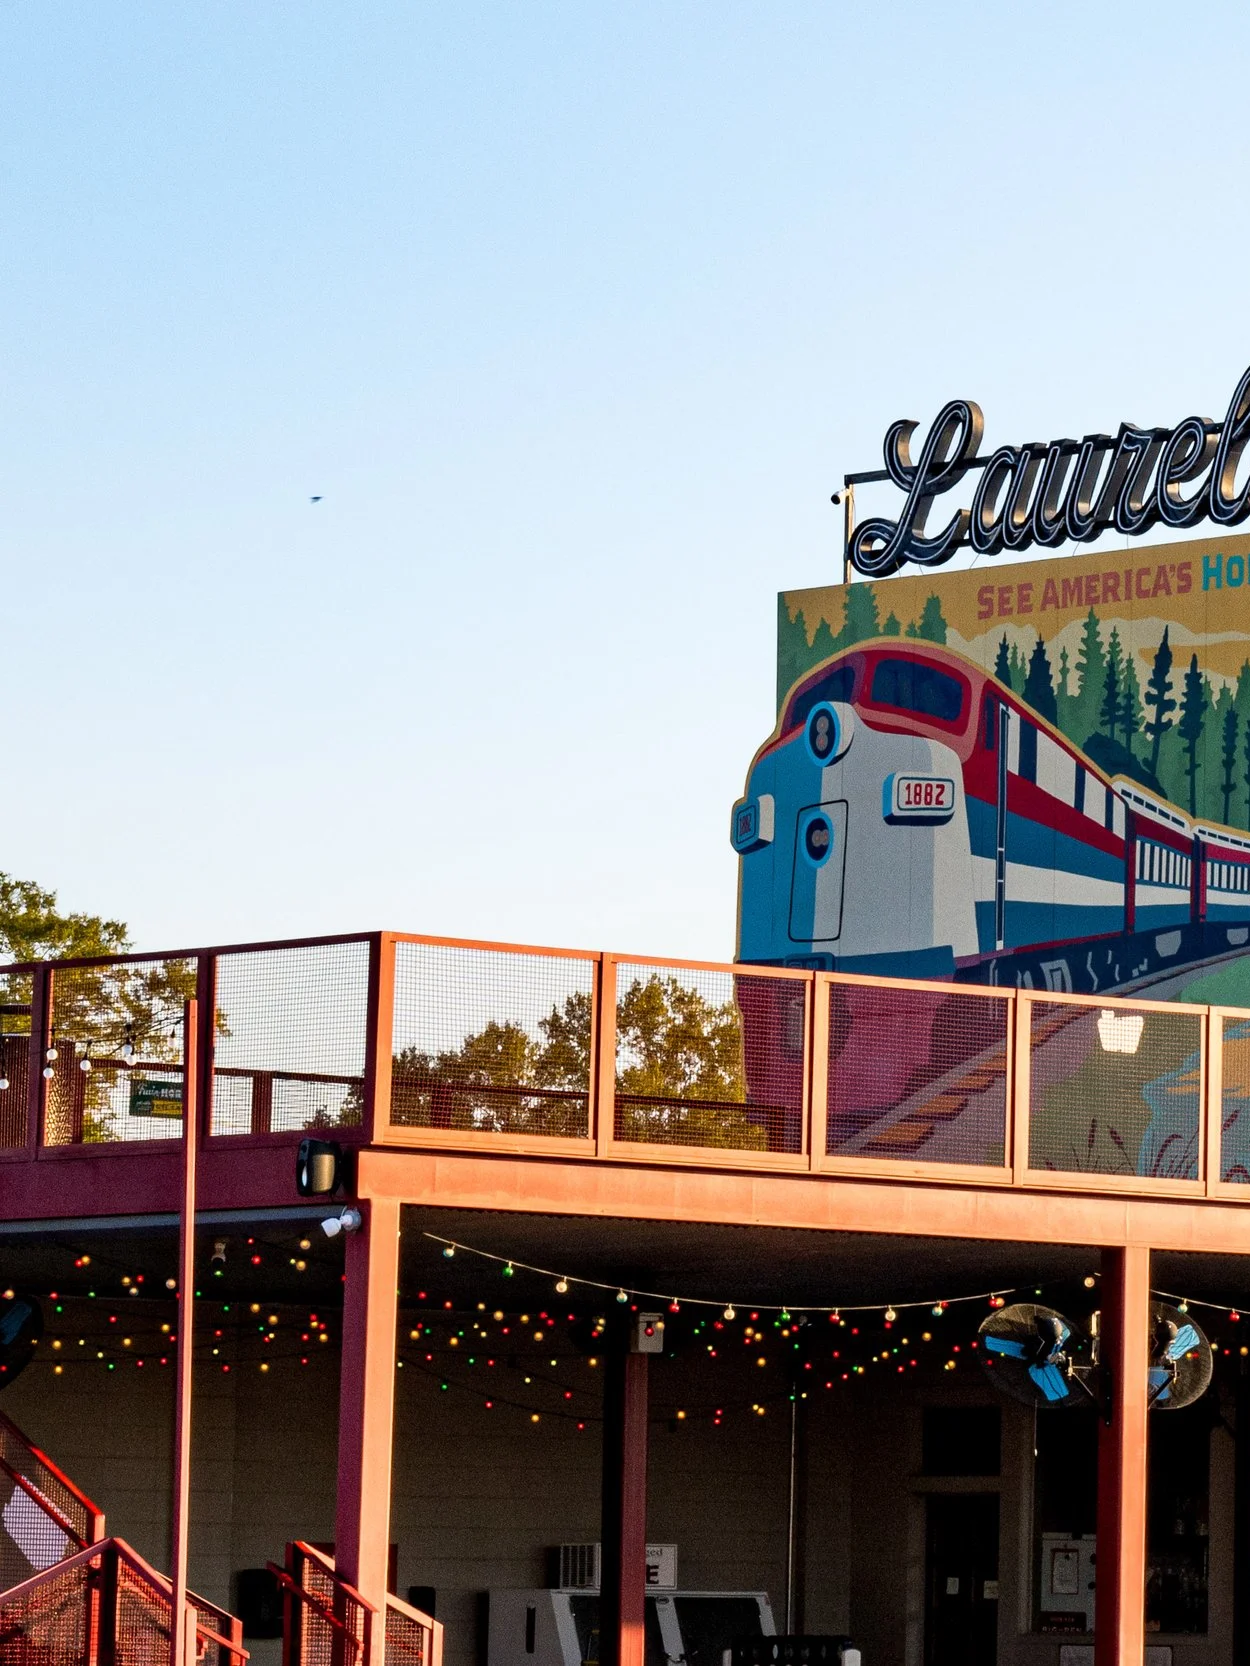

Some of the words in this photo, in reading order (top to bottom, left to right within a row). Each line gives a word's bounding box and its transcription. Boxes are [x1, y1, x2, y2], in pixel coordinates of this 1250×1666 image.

[977, 583, 1035, 620] SEE
[1040, 561, 1192, 612] AMERICA'S
[904, 783, 946, 806] 1882
